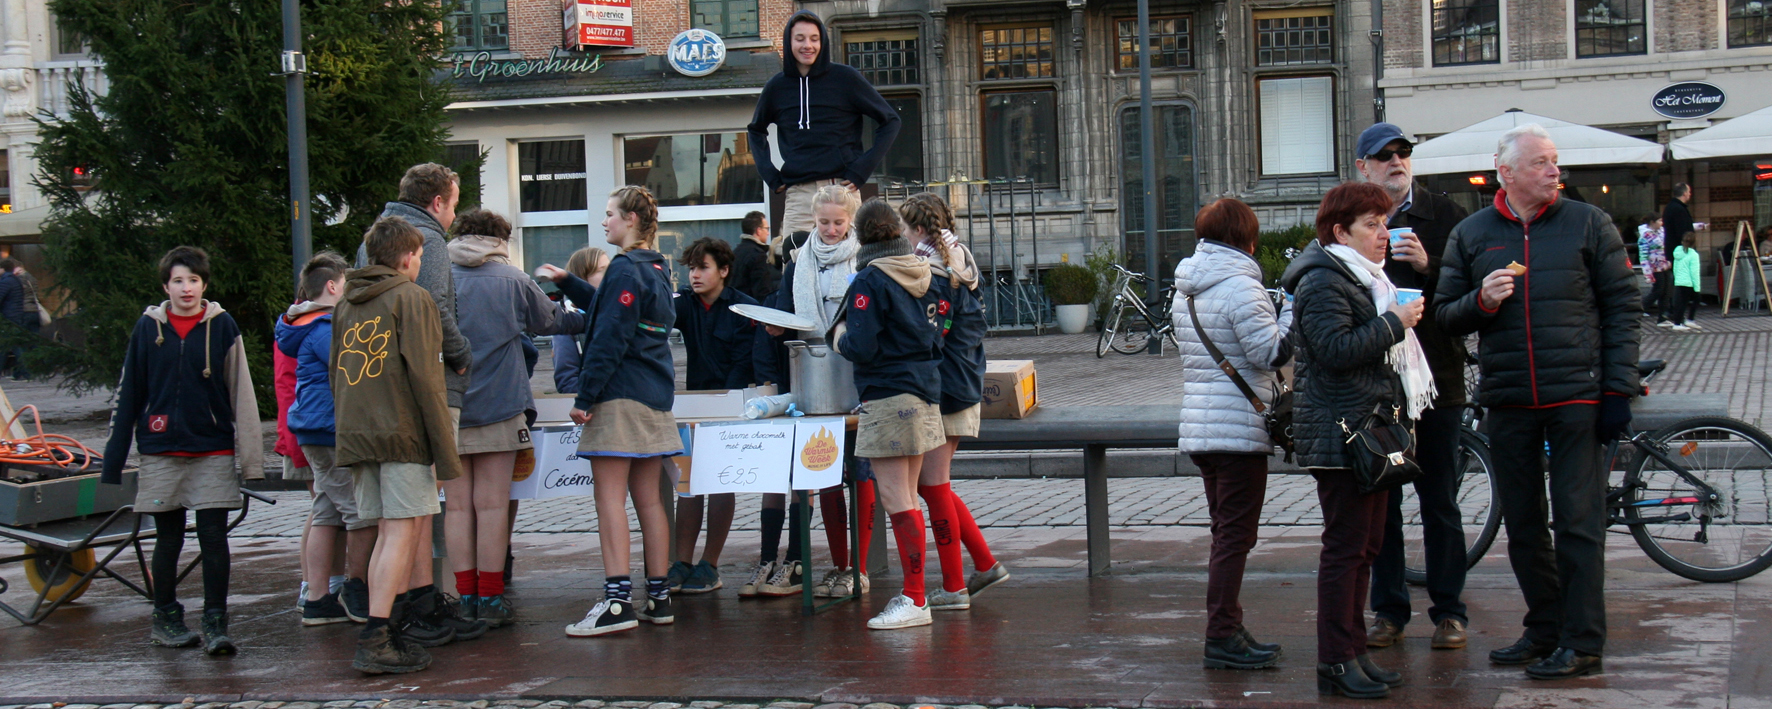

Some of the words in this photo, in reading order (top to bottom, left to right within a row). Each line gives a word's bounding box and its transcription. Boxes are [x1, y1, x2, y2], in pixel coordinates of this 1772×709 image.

[586, 27, 625, 36] 0477/477.477
[671, 43, 722, 62] MAES
[469, 46, 605, 83] Groenhuis
[1655, 94, 1680, 106] Het
[1682, 94, 1721, 104] Moment
[560, 431, 581, 444] GES
[719, 431, 749, 440] Warme
[741, 442, 765, 452] gebak
[815, 440, 827, 448] De
[808, 454, 831, 463] Week
[717, 465, 759, 486] €2,5
[933, 519, 952, 546] CHIRO
[909, 552, 922, 574] CHIRO
